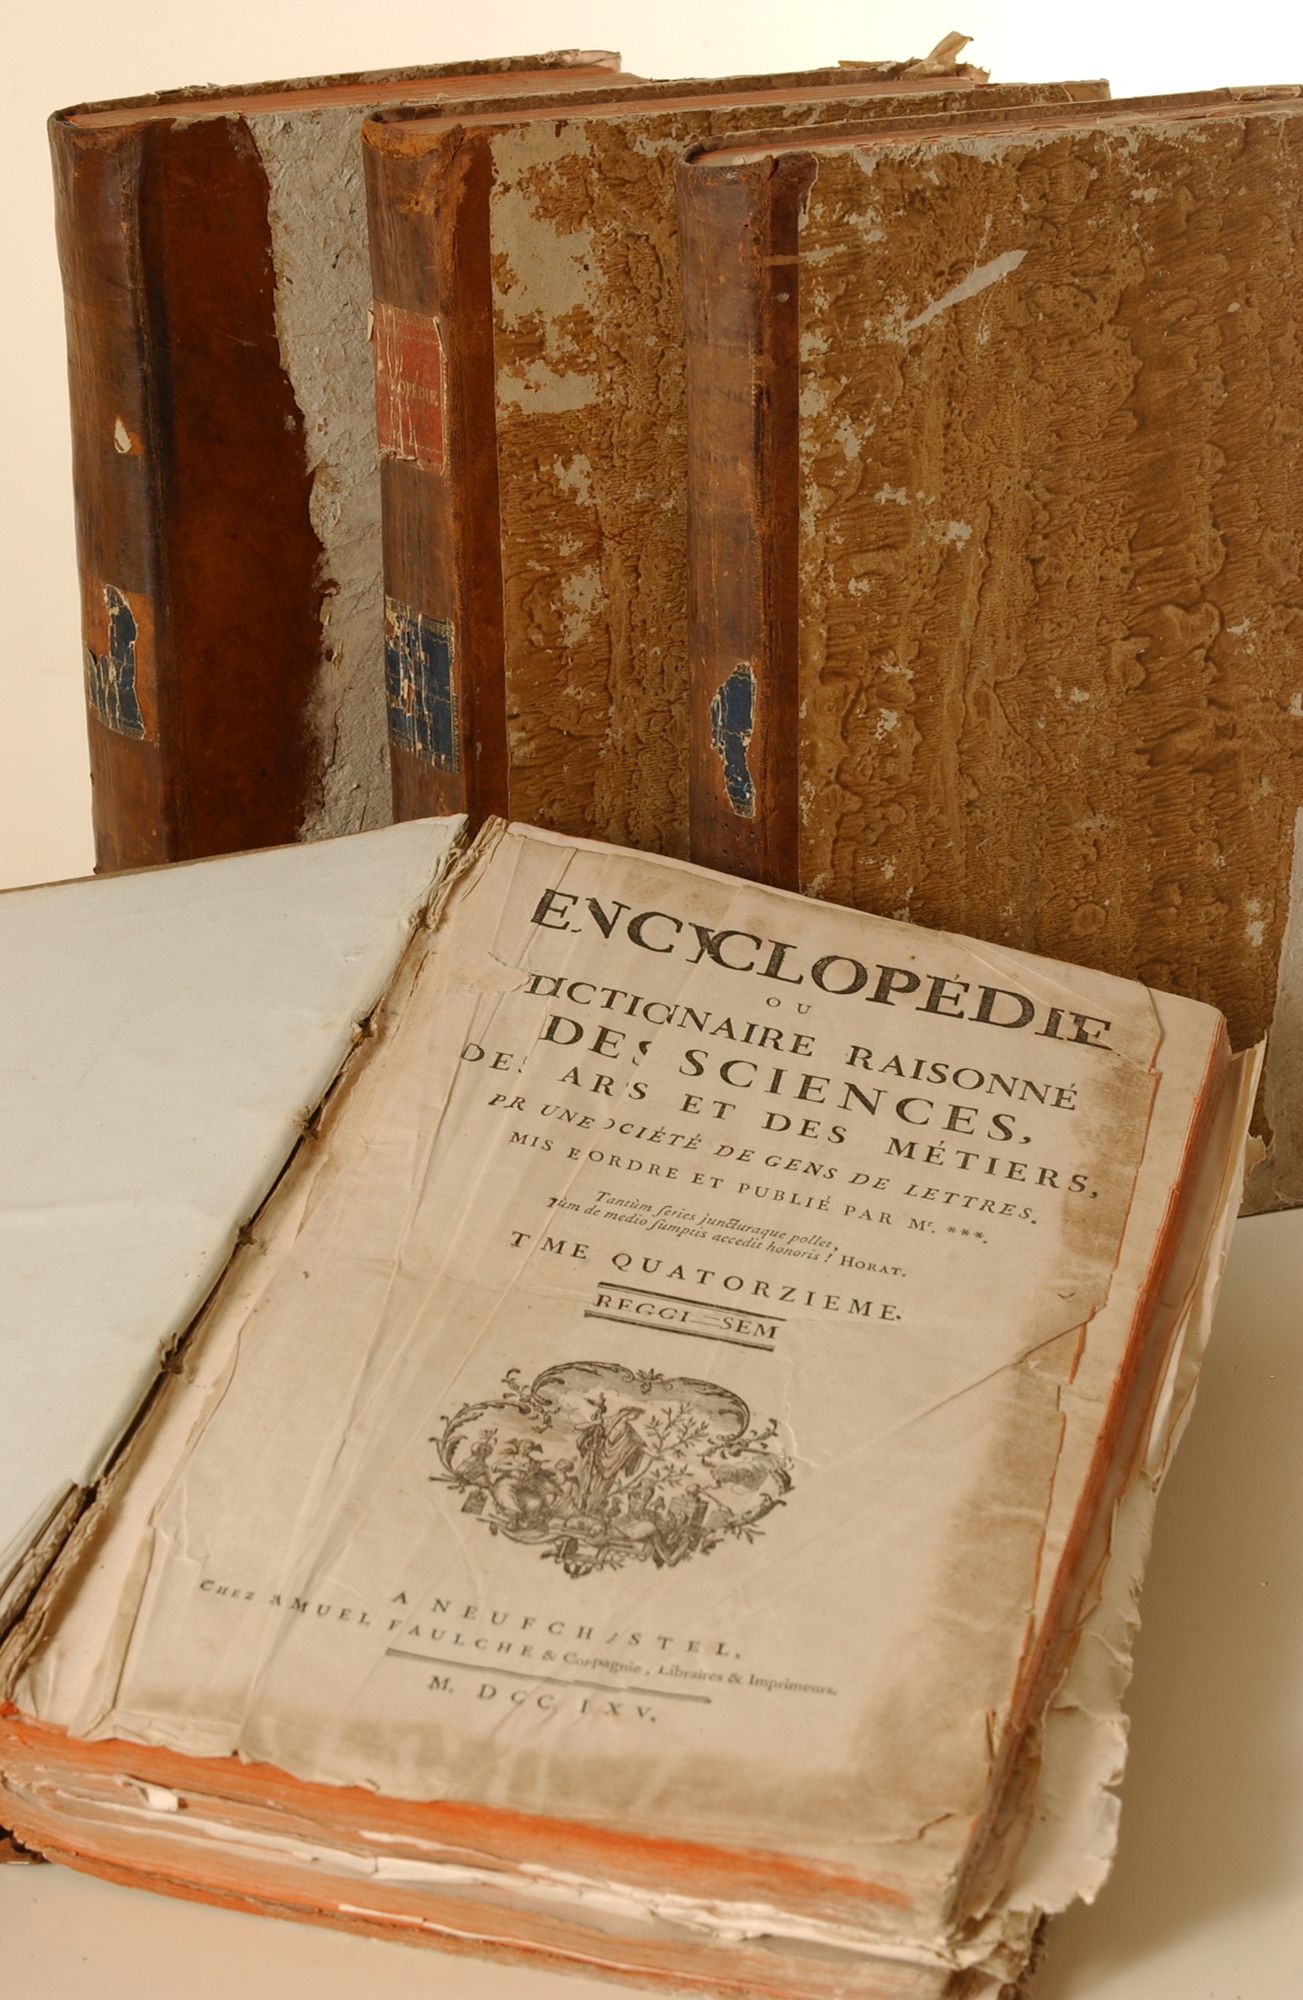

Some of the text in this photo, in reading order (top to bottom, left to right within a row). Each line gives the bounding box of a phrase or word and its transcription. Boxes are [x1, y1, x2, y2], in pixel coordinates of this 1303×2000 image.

[766, 996, 813, 1016] OU
[679, 1049, 1032, 1145] SCIENCES,
[845, 1045, 1079, 1111] RAISONNÉ
[460, 1043, 1100, 1199] DE ARS ET DES MÉTIERS,
[488, 1093, 1037, 1224] PR UNE OCIÉTÉ DE GENS DE LETTRES.
[509, 1131, 554, 1151] MIS
[691, 1172, 725, 1190] ET
[738, 1182, 832, 1212] PUBLIÉ
[843, 1204, 893, 1225] PAR
[583, 1204, 601, 1216] de
[510, 1230, 901, 1321] TME QUATORZIEME.
[269, 1593, 371, 1627] AMUEL
[391, 1590, 408, 1605] A
